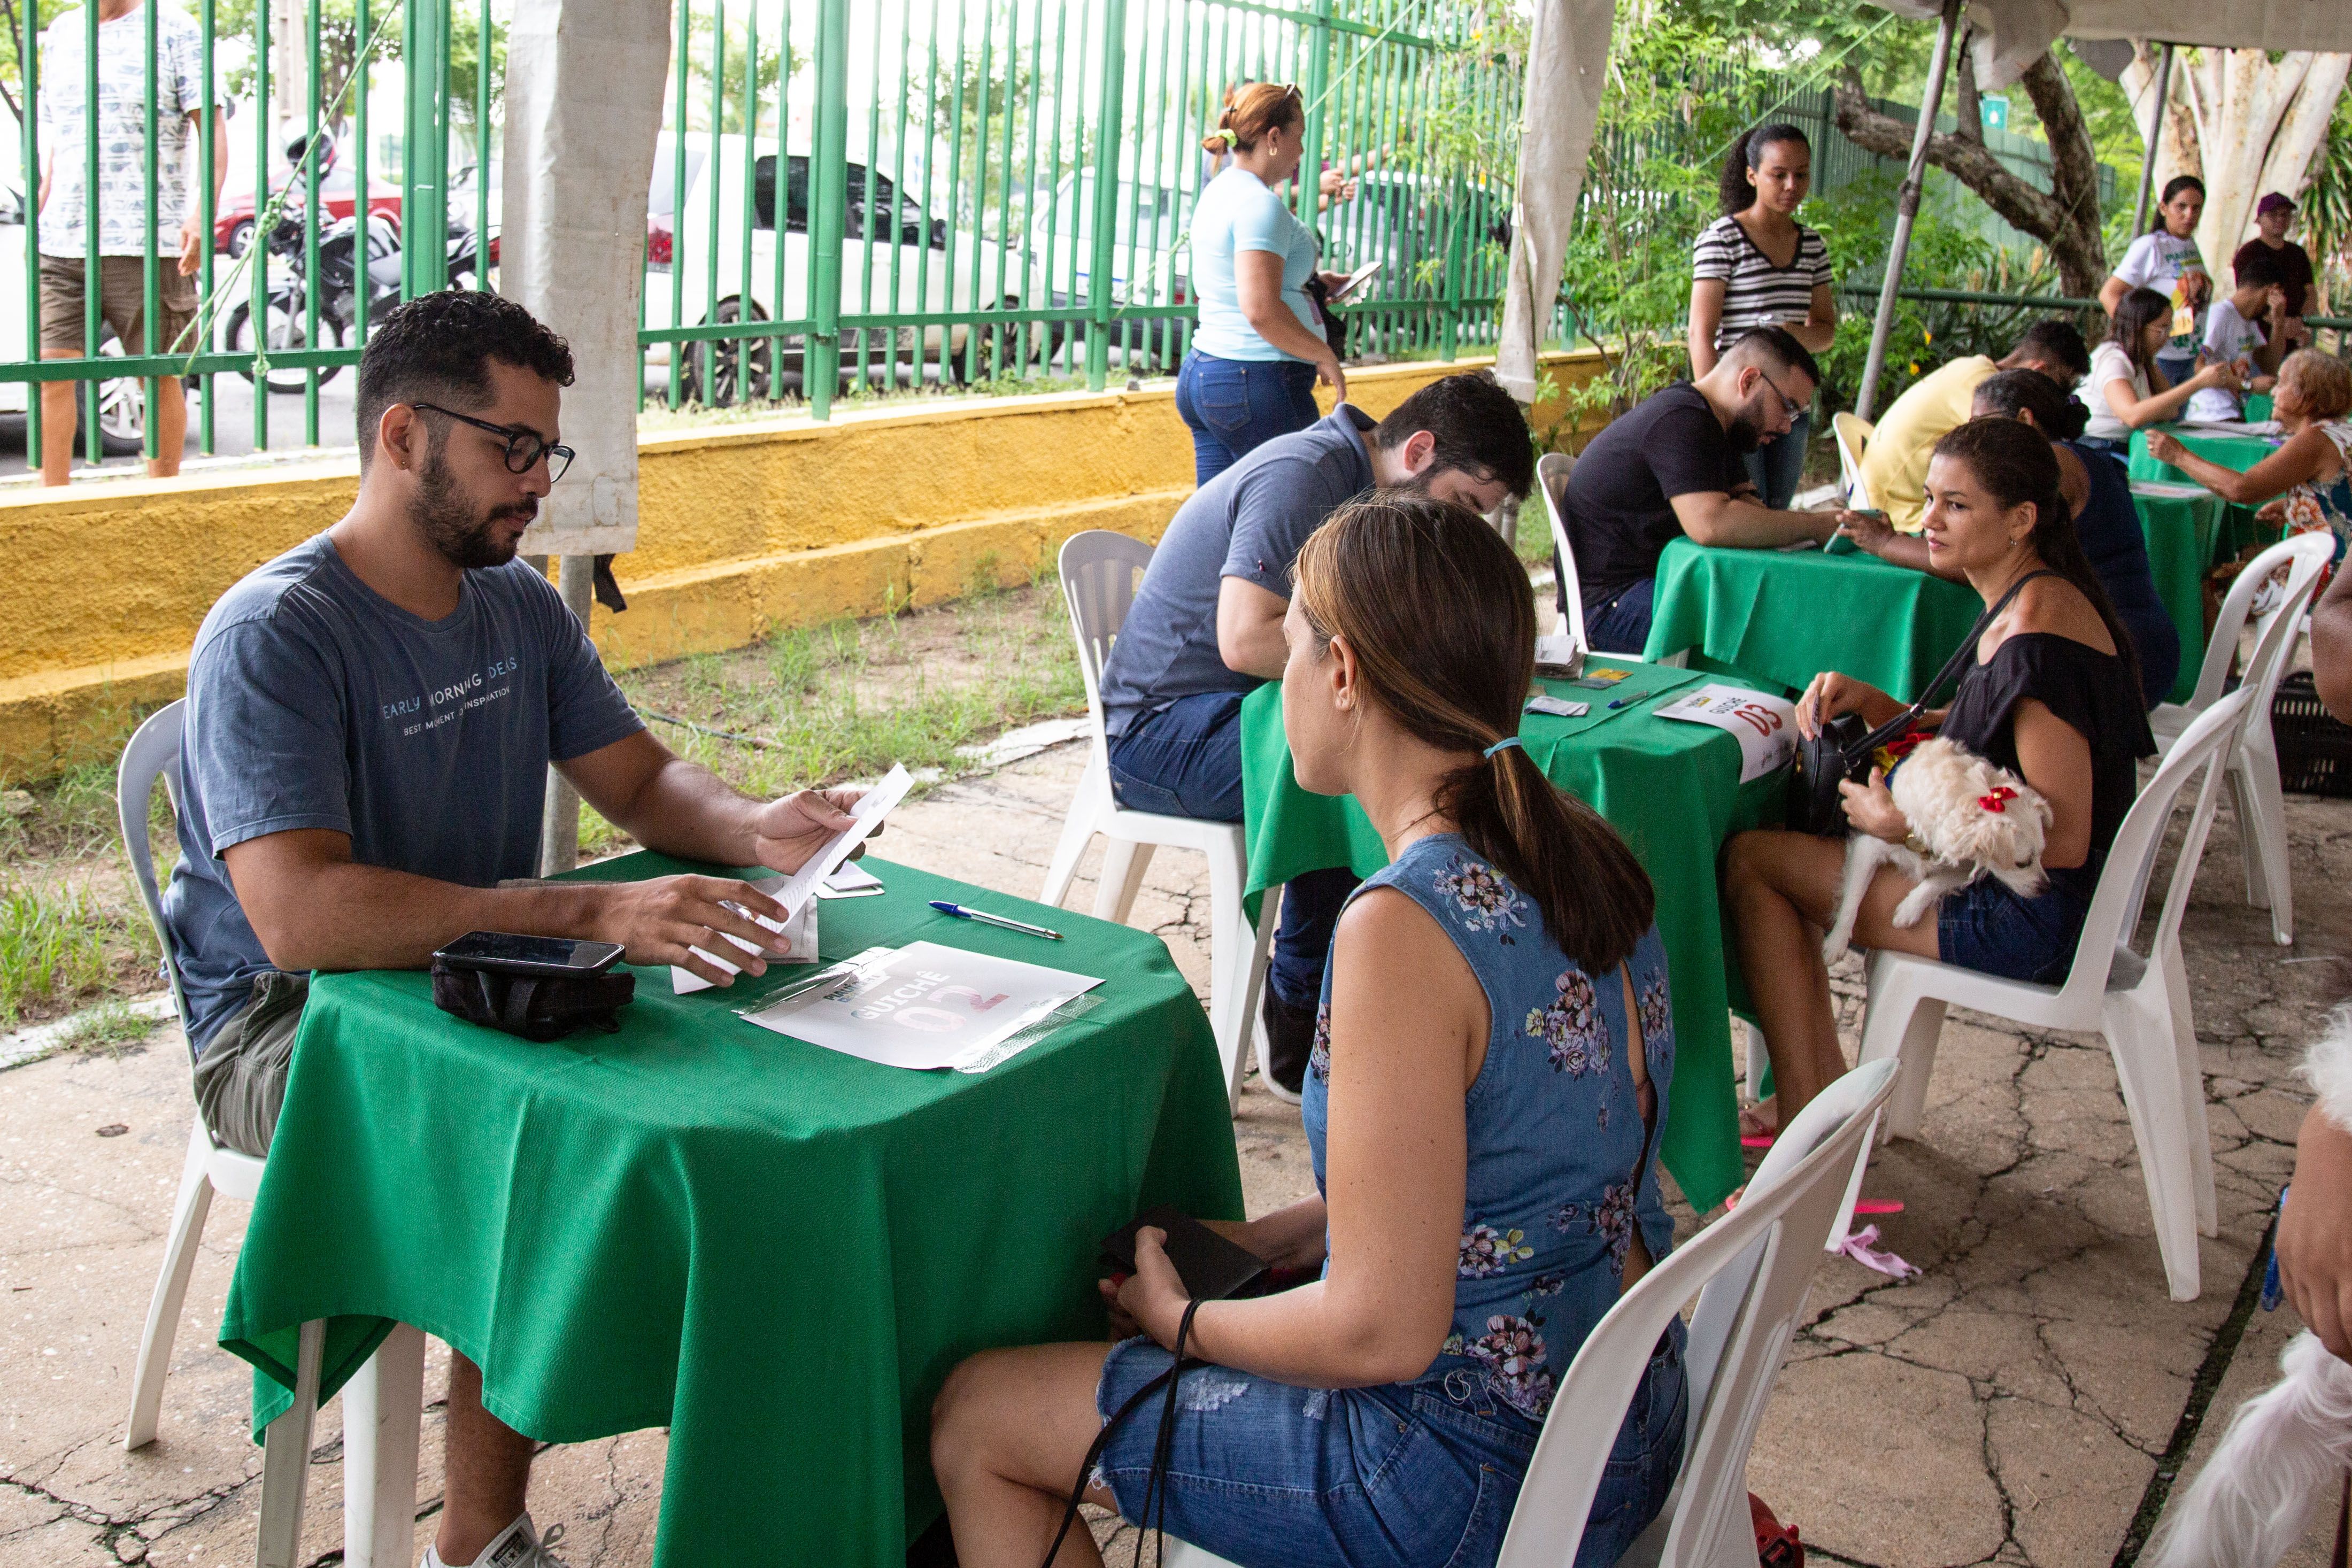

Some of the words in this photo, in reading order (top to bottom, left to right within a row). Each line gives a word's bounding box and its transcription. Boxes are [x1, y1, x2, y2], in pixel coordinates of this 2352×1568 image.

[382, 697, 420, 720] EARLY
[1733, 704, 1783, 737] 03
[404, 723, 421, 737] BEST
[851, 970, 951, 1020] GUICHÊ
[892, 985, 1011, 1032] 02
